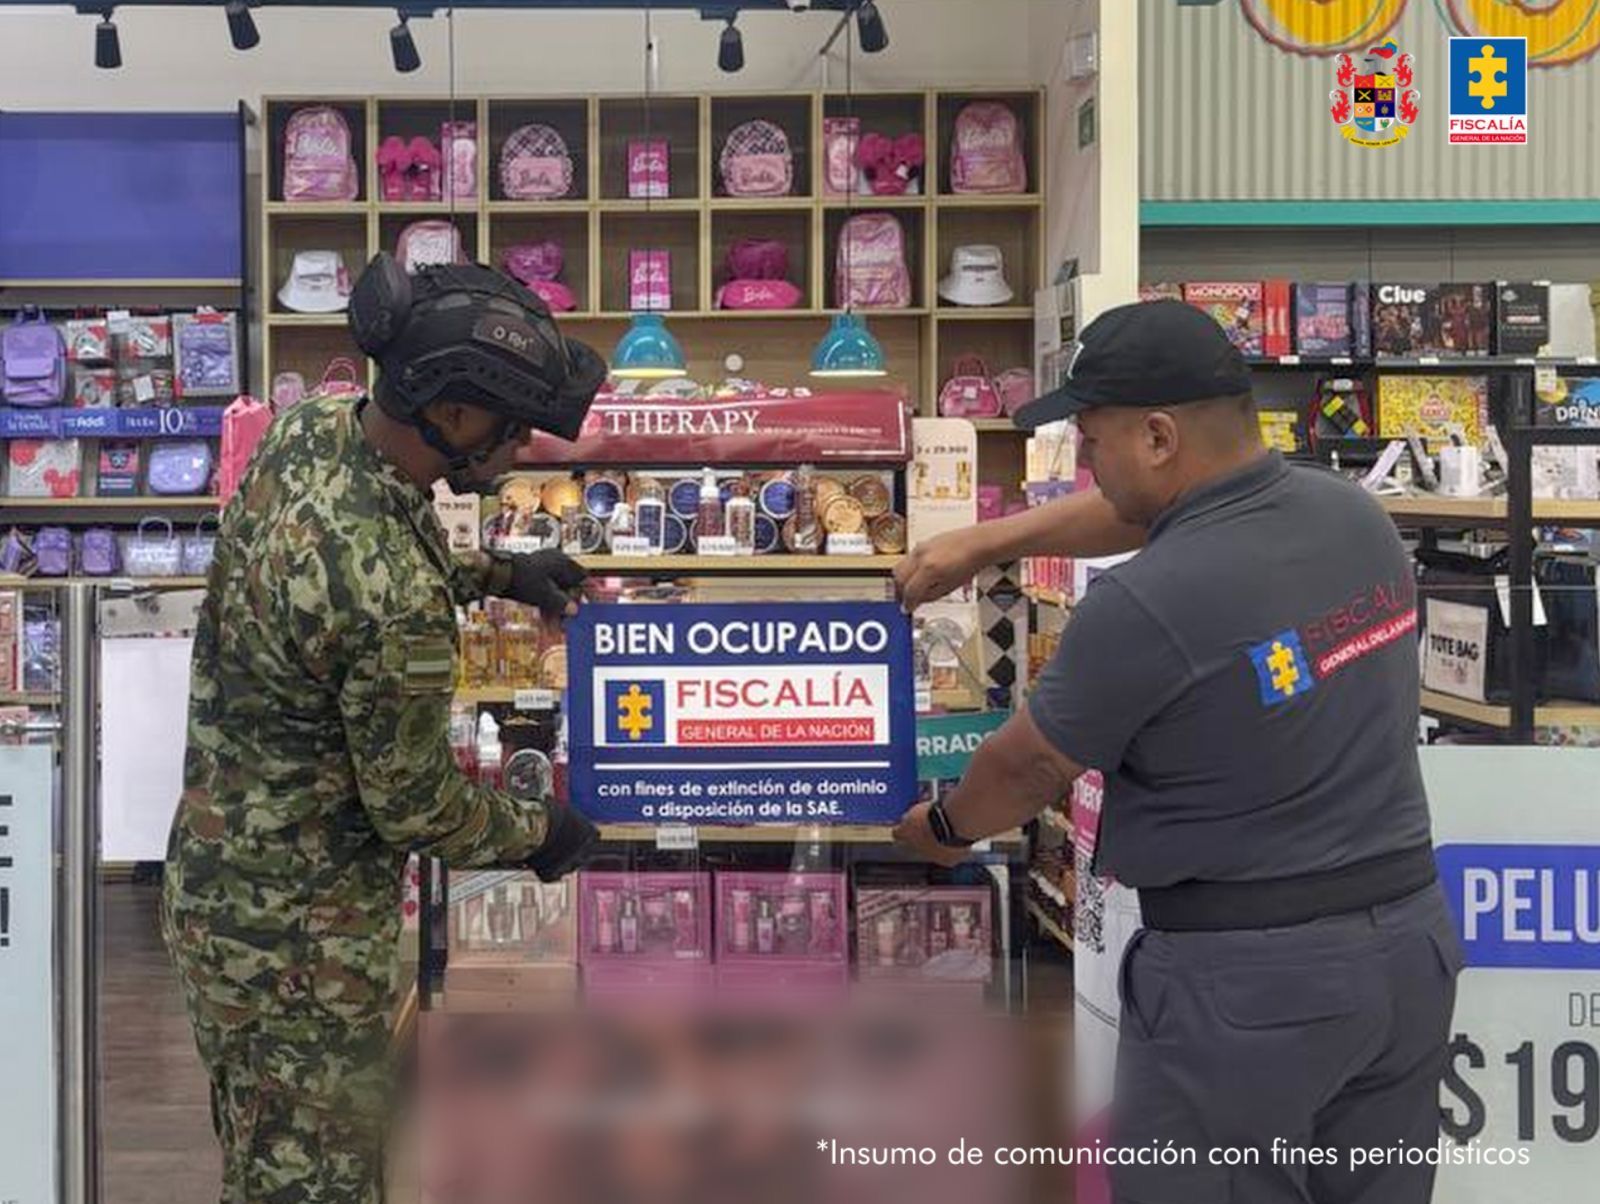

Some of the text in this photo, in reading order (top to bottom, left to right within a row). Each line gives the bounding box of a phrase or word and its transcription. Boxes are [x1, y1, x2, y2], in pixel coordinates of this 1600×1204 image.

[1188, 286, 1258, 300] MONOPOLY
[1378, 285, 1426, 304] Clue
[159, 408, 184, 434] 10
[605, 408, 761, 437] THERAPY
[594, 620, 888, 654] BIEN OCUPADO
[1430, 634, 1479, 661] TOTE BAG
[677, 672, 873, 708] FISCALÍA
[681, 721, 871, 740] GENERAL DE LA NACIÓN
[598, 779, 887, 796] con fines de extinción de dominio
[641, 800, 843, 819] a disposición de la SAE.
